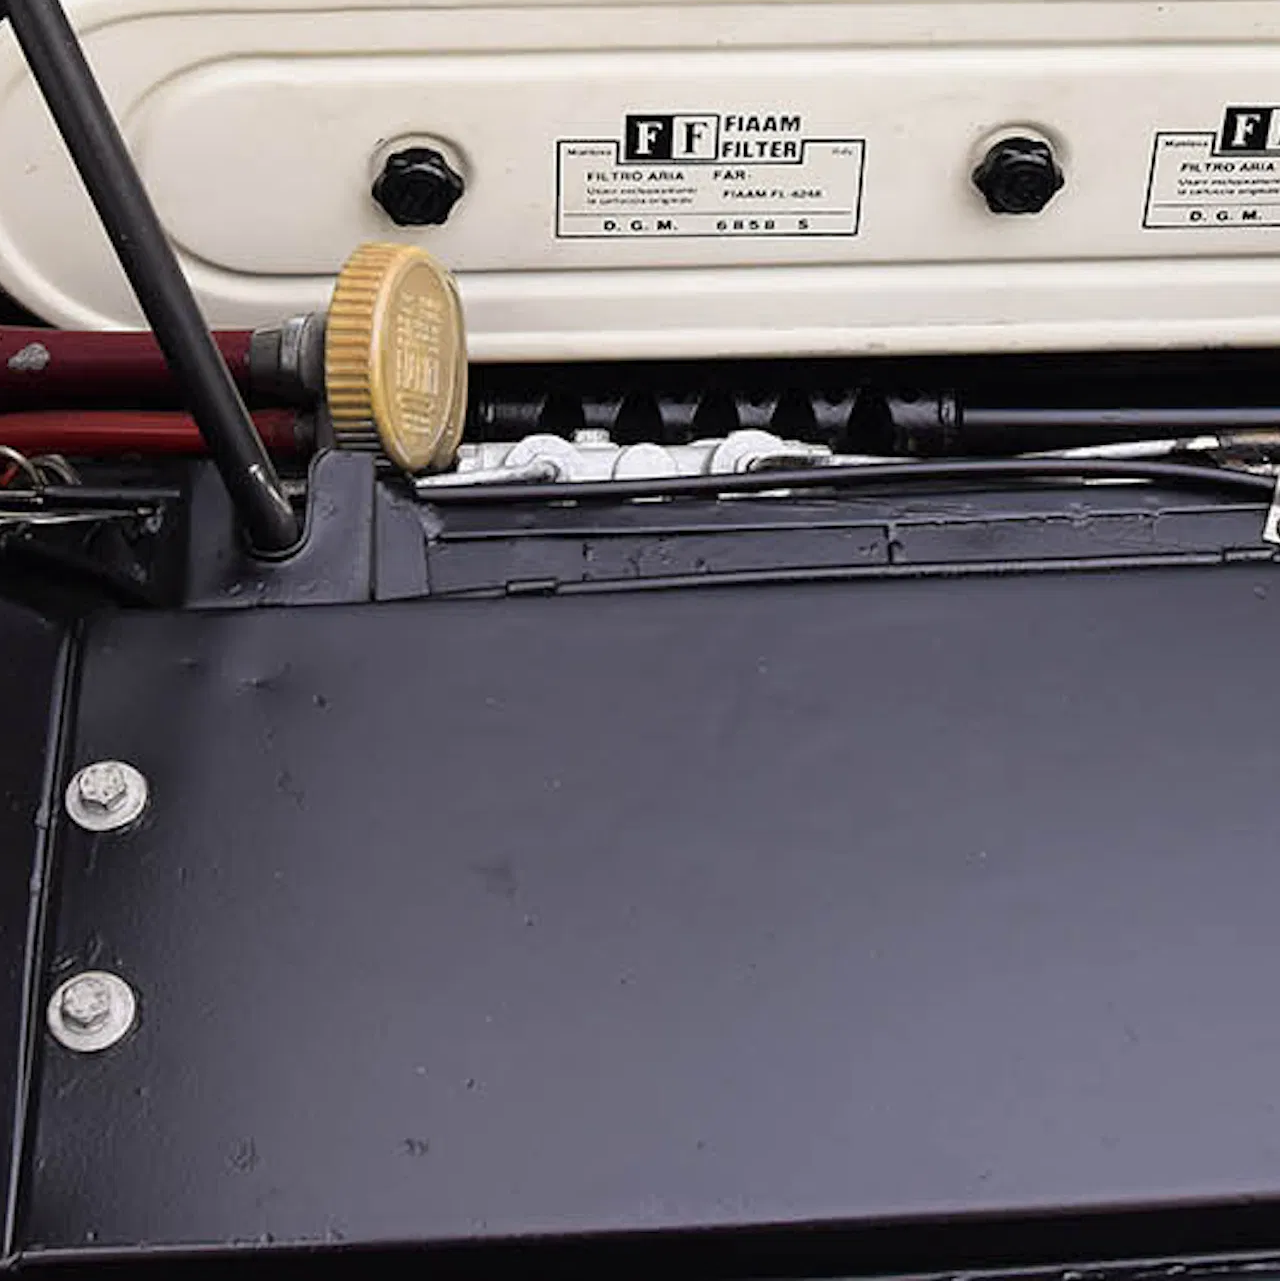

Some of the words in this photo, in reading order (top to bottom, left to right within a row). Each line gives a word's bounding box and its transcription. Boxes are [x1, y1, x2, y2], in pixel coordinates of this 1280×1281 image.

[724, 115, 802, 132] FIAAM
[721, 140, 798, 158] FILTER
[586, 170, 643, 181] FILTRO
[646, 170, 685, 181] ARIA
